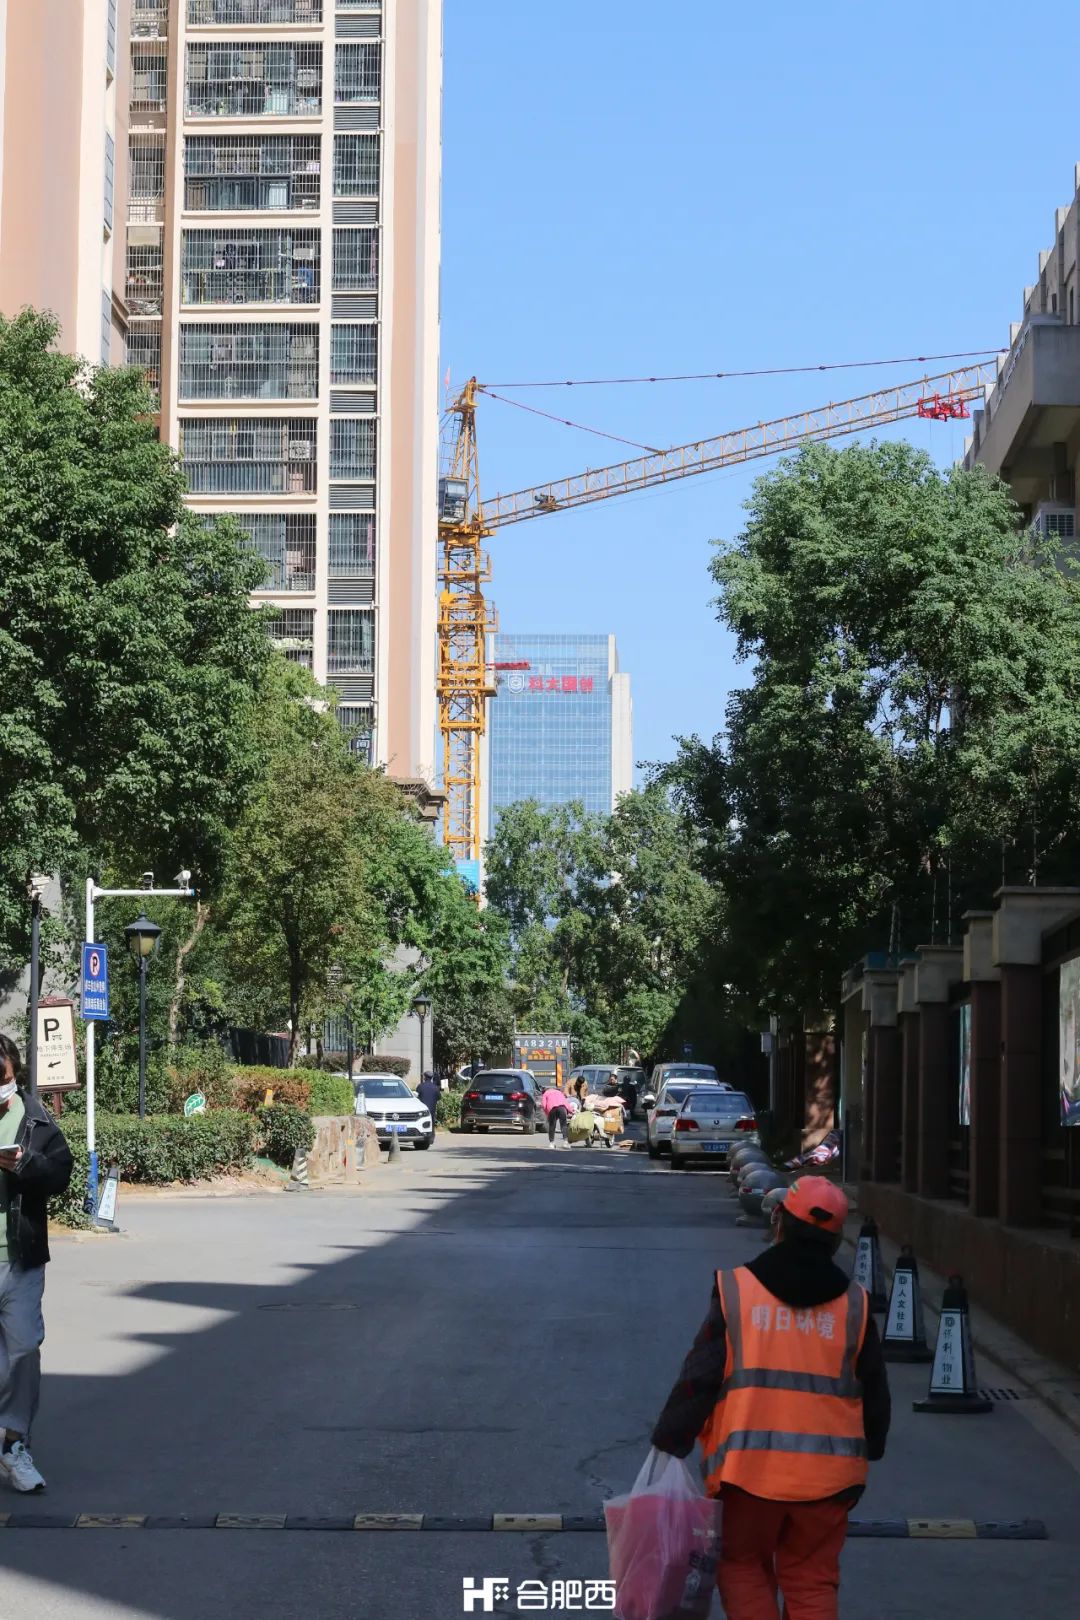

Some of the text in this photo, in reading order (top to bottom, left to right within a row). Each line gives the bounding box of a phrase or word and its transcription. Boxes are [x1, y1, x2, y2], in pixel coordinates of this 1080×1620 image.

[43, 1018, 60, 1041] P
[895, 1288, 907, 1332] 人文社区
